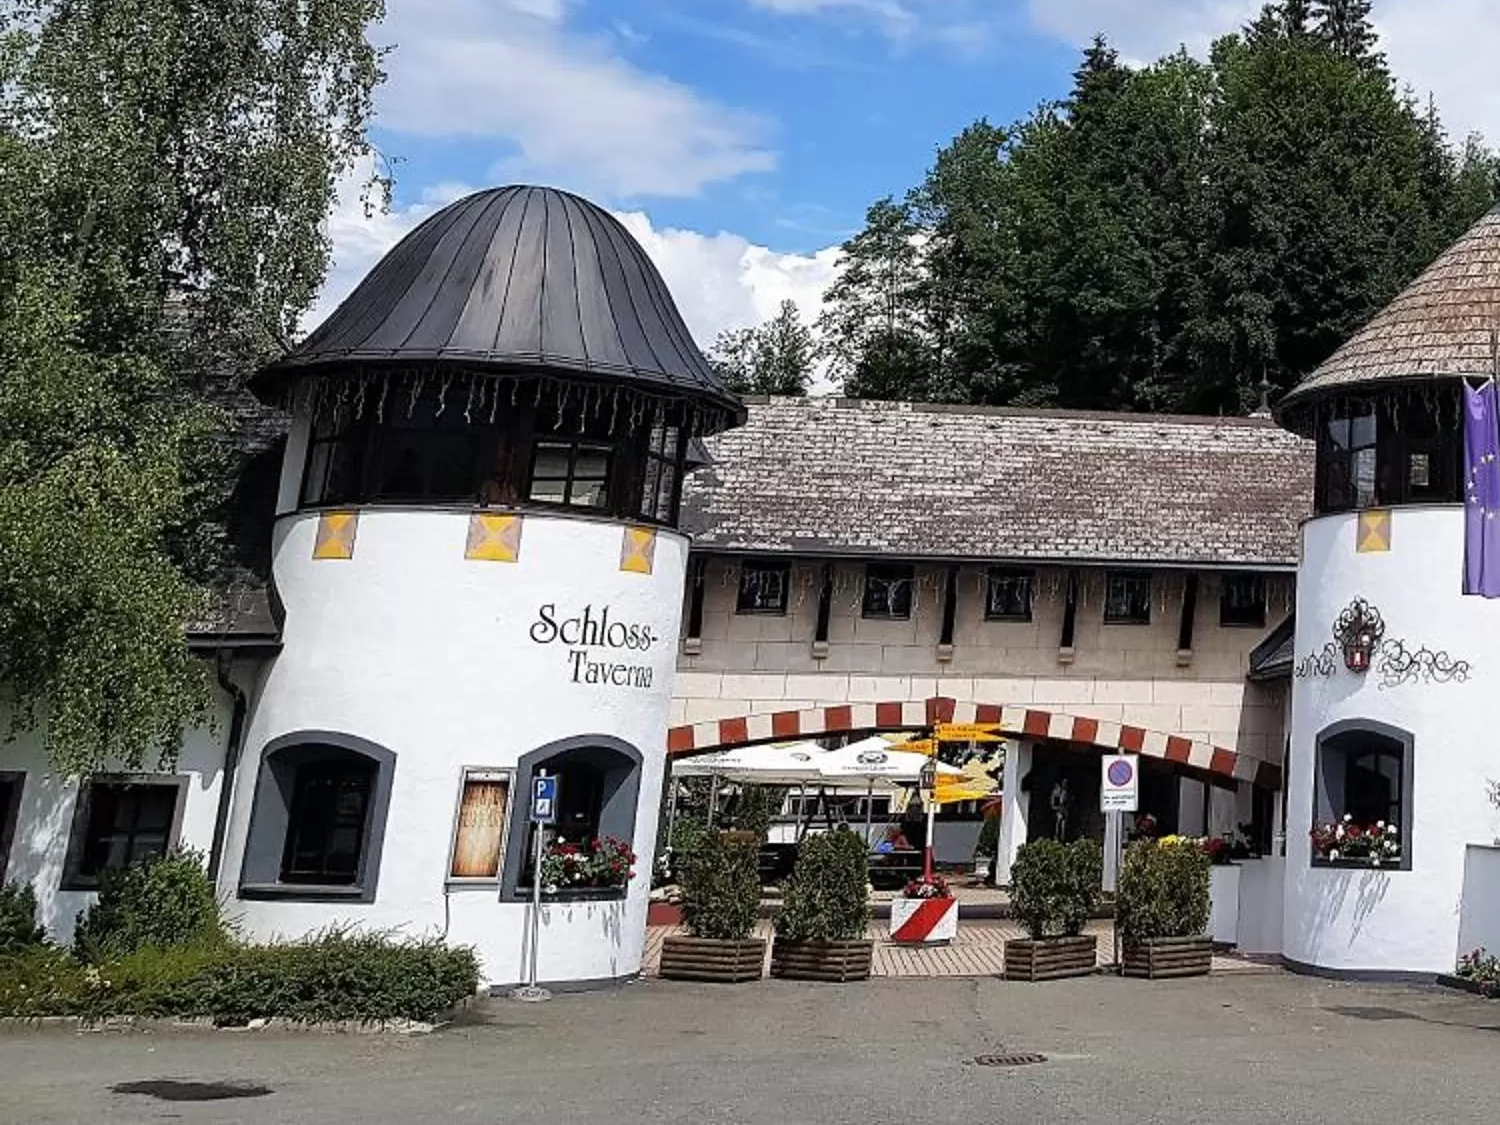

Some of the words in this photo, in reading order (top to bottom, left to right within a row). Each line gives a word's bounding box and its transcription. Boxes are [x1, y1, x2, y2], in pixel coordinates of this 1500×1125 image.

[529, 602, 658, 652] Schloss-
[567, 648, 653, 688] Taverna
[537, 780, 547, 797] P
